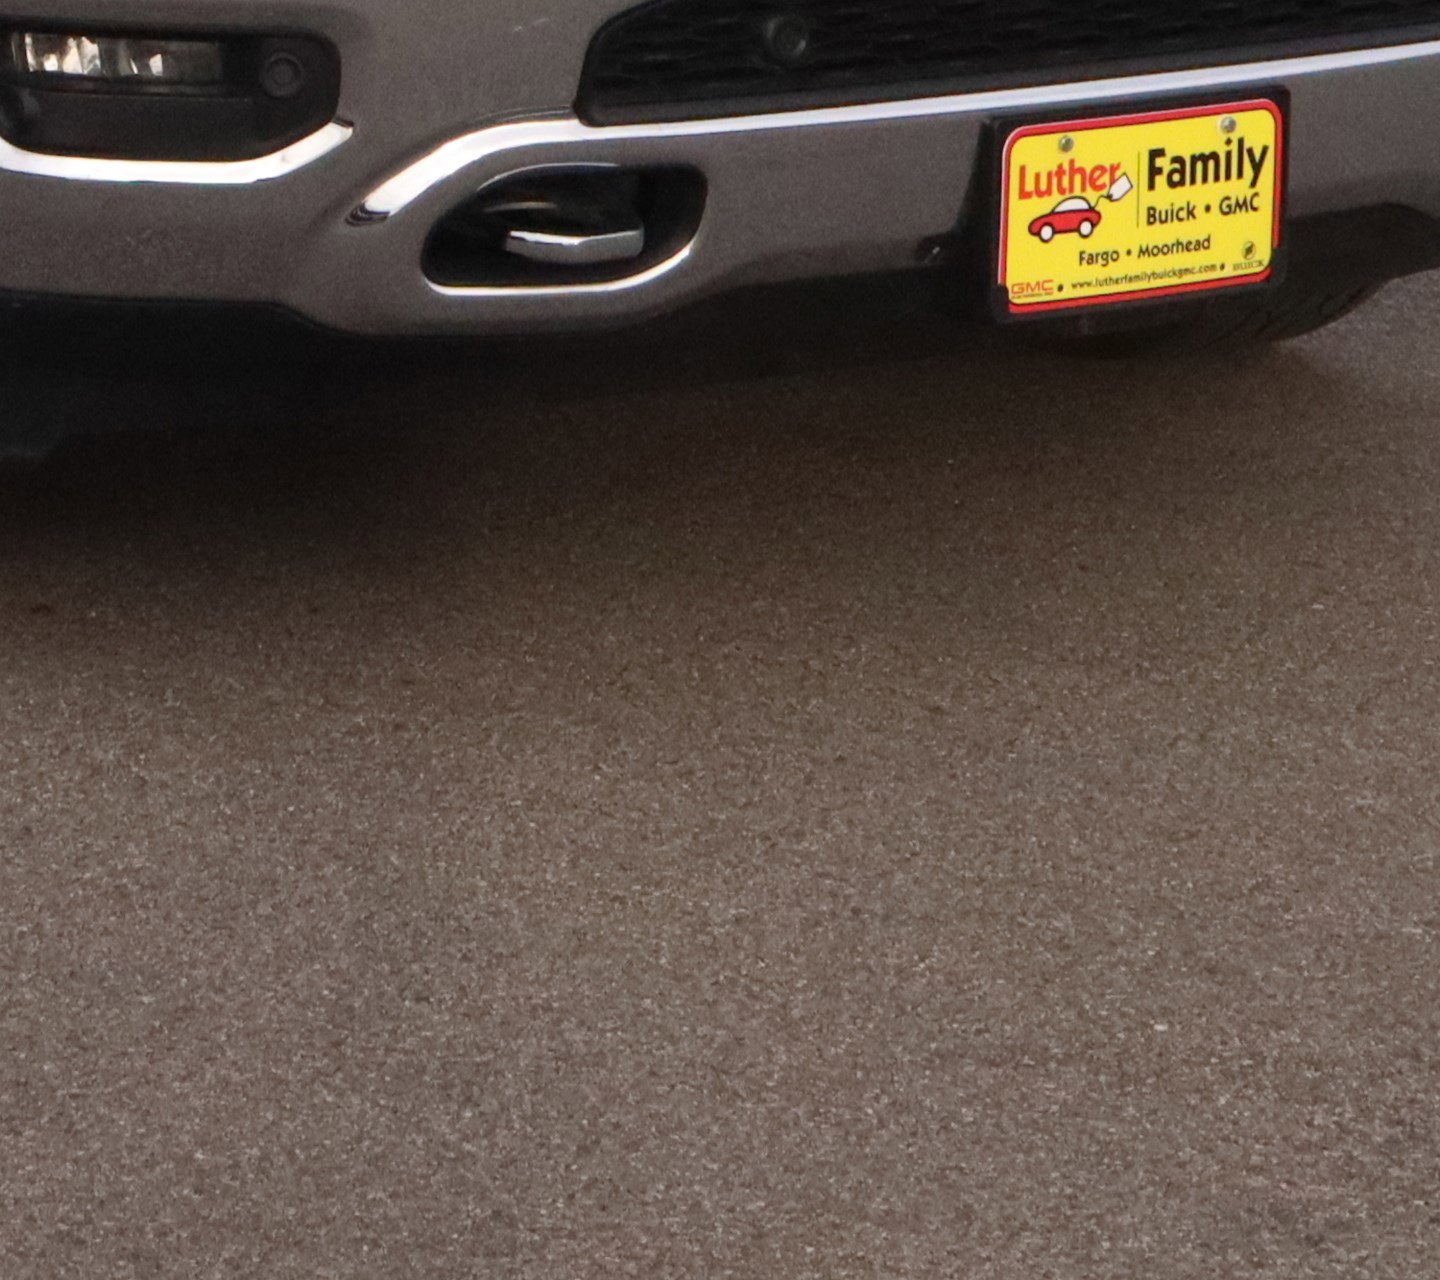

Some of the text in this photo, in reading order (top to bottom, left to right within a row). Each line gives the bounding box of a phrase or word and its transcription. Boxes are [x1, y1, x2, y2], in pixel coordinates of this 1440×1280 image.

[1018, 158, 1121, 201] Luther
[1147, 136, 1270, 192] Family
[1146, 192, 1260, 227] Buick GMC
[1078, 234, 1212, 268] Fargo Moorhead
[1010, 278, 1054, 295] GMC
